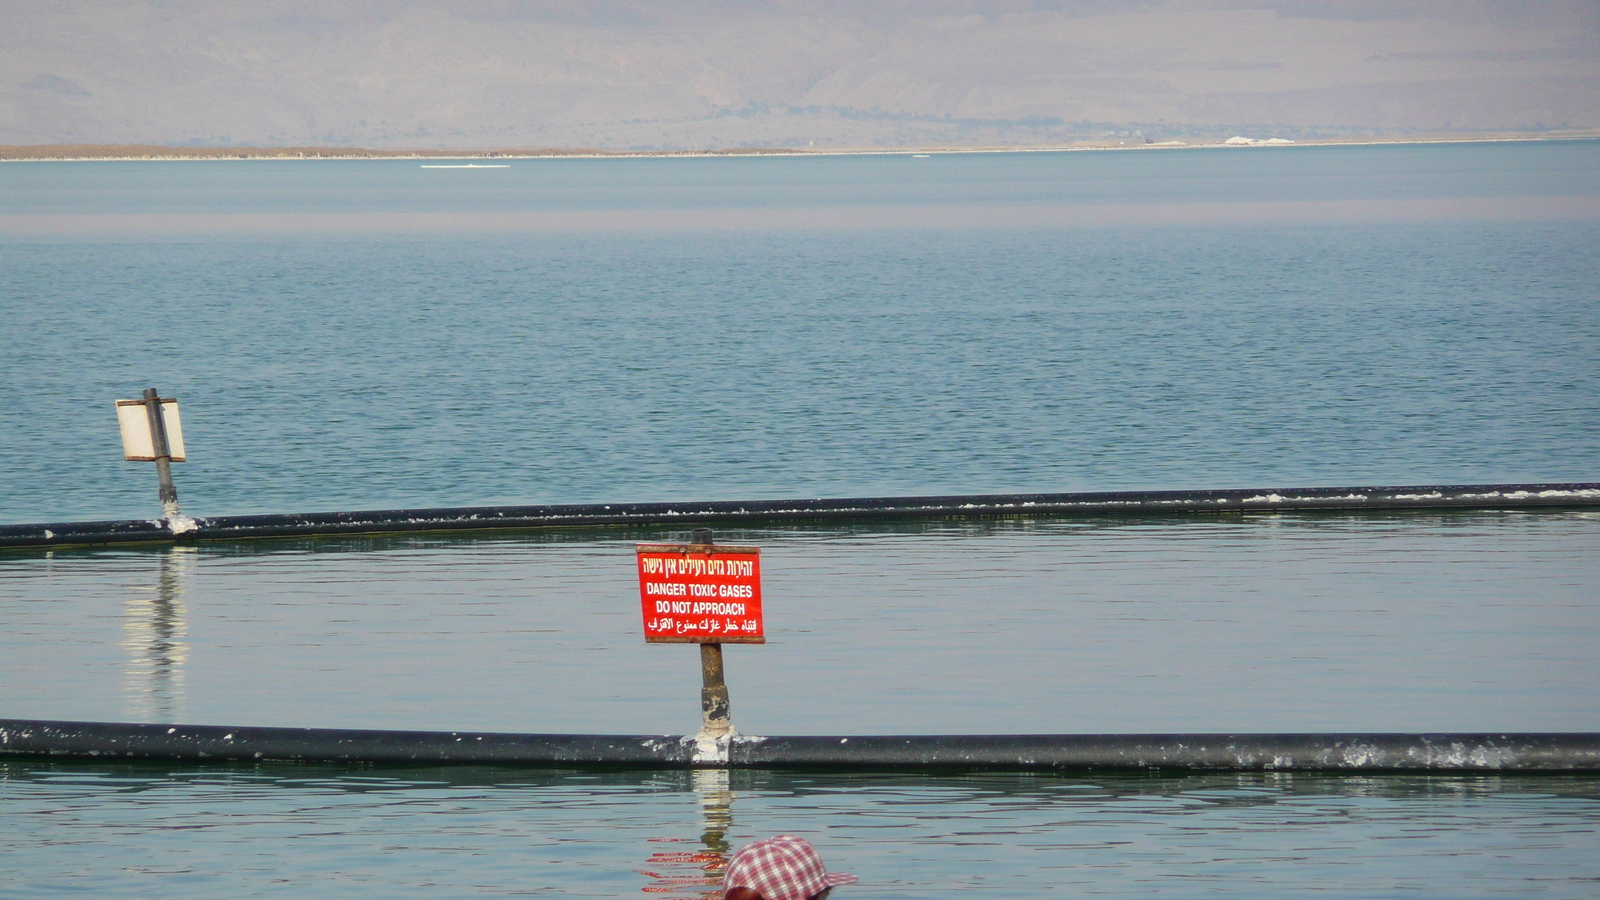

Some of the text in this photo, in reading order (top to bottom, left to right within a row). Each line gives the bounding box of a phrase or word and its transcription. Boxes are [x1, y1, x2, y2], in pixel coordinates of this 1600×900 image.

[642, 557, 664, 574] גישה
[665, 558, 677, 578] אין
[679, 556, 706, 577] רעילים
[708, 559, 725, 576] גזים
[646, 582, 753, 598] DANGER TOXIC GASES
[656, 600, 745, 616] DO NOT APPROACH
[676, 619, 697, 634] ممنوع
[723, 618, 739, 634] خطر
